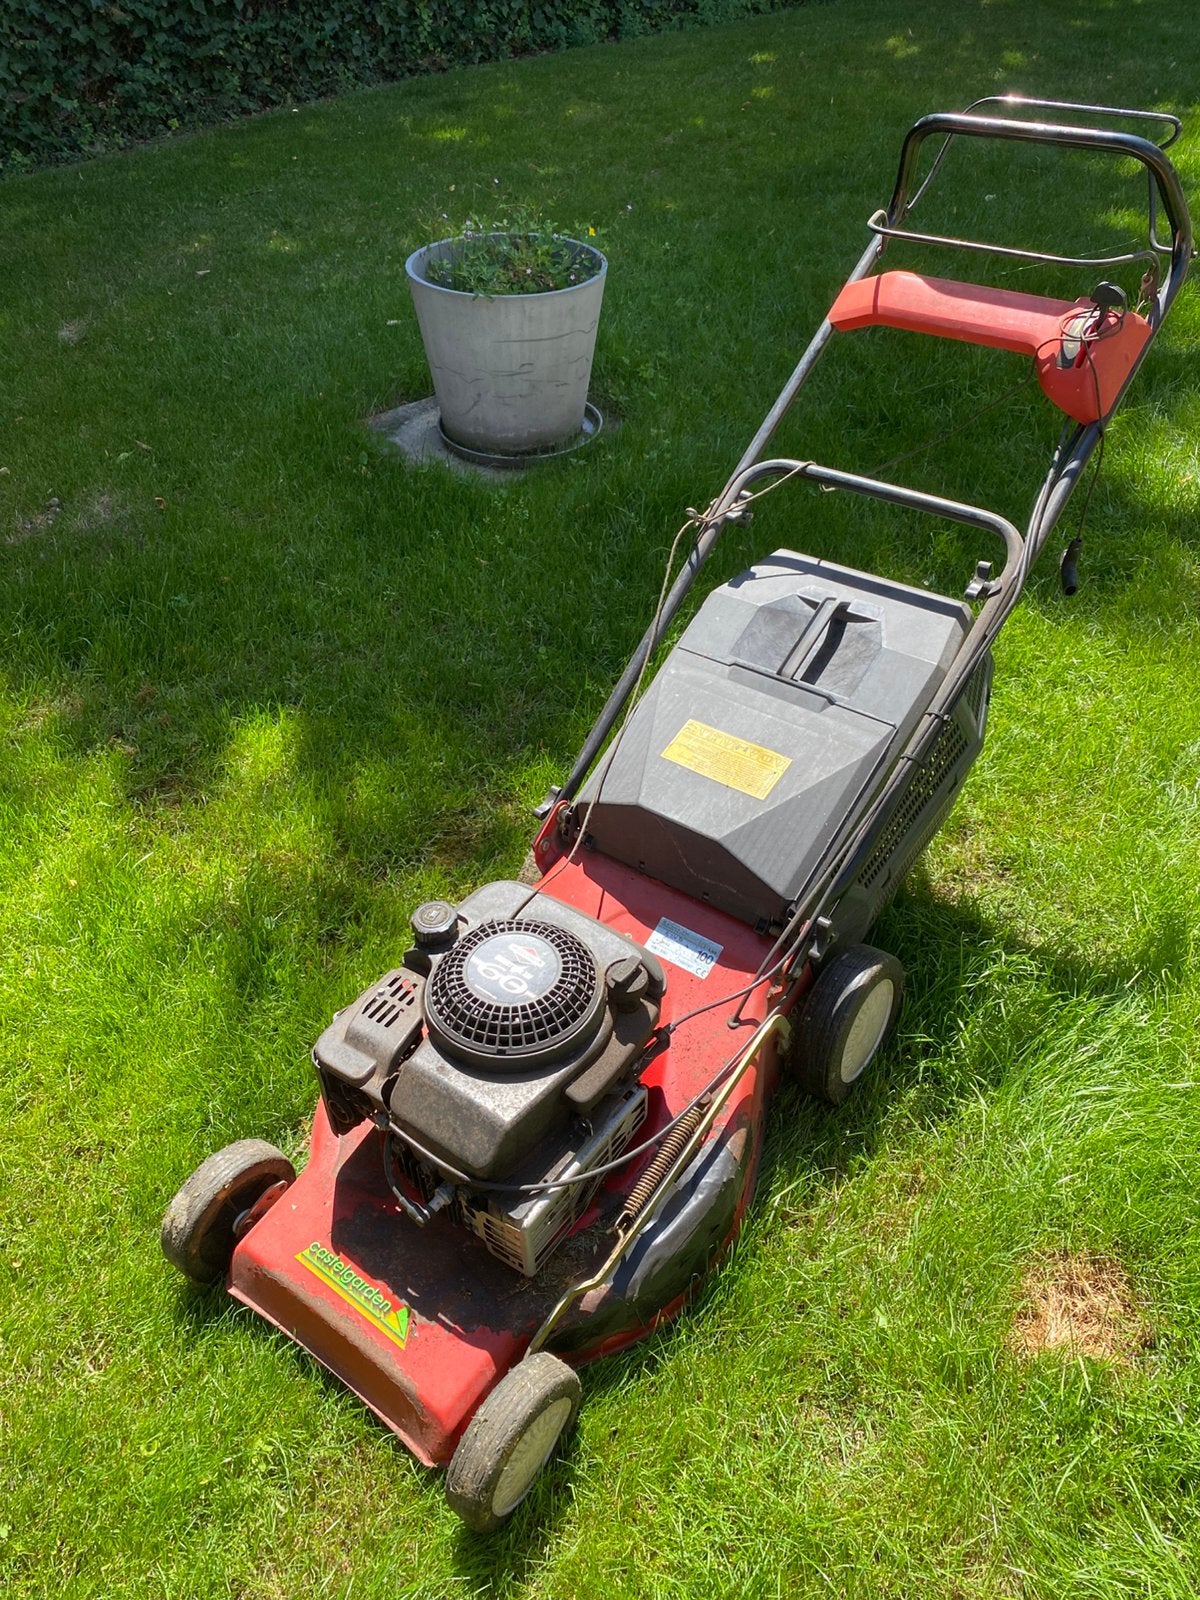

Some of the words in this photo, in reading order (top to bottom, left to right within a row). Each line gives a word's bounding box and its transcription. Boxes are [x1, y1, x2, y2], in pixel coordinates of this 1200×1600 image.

[696, 950, 714, 965] 100
[695, 967, 707, 977] CE
[308, 1241, 392, 1313] castelgarden
